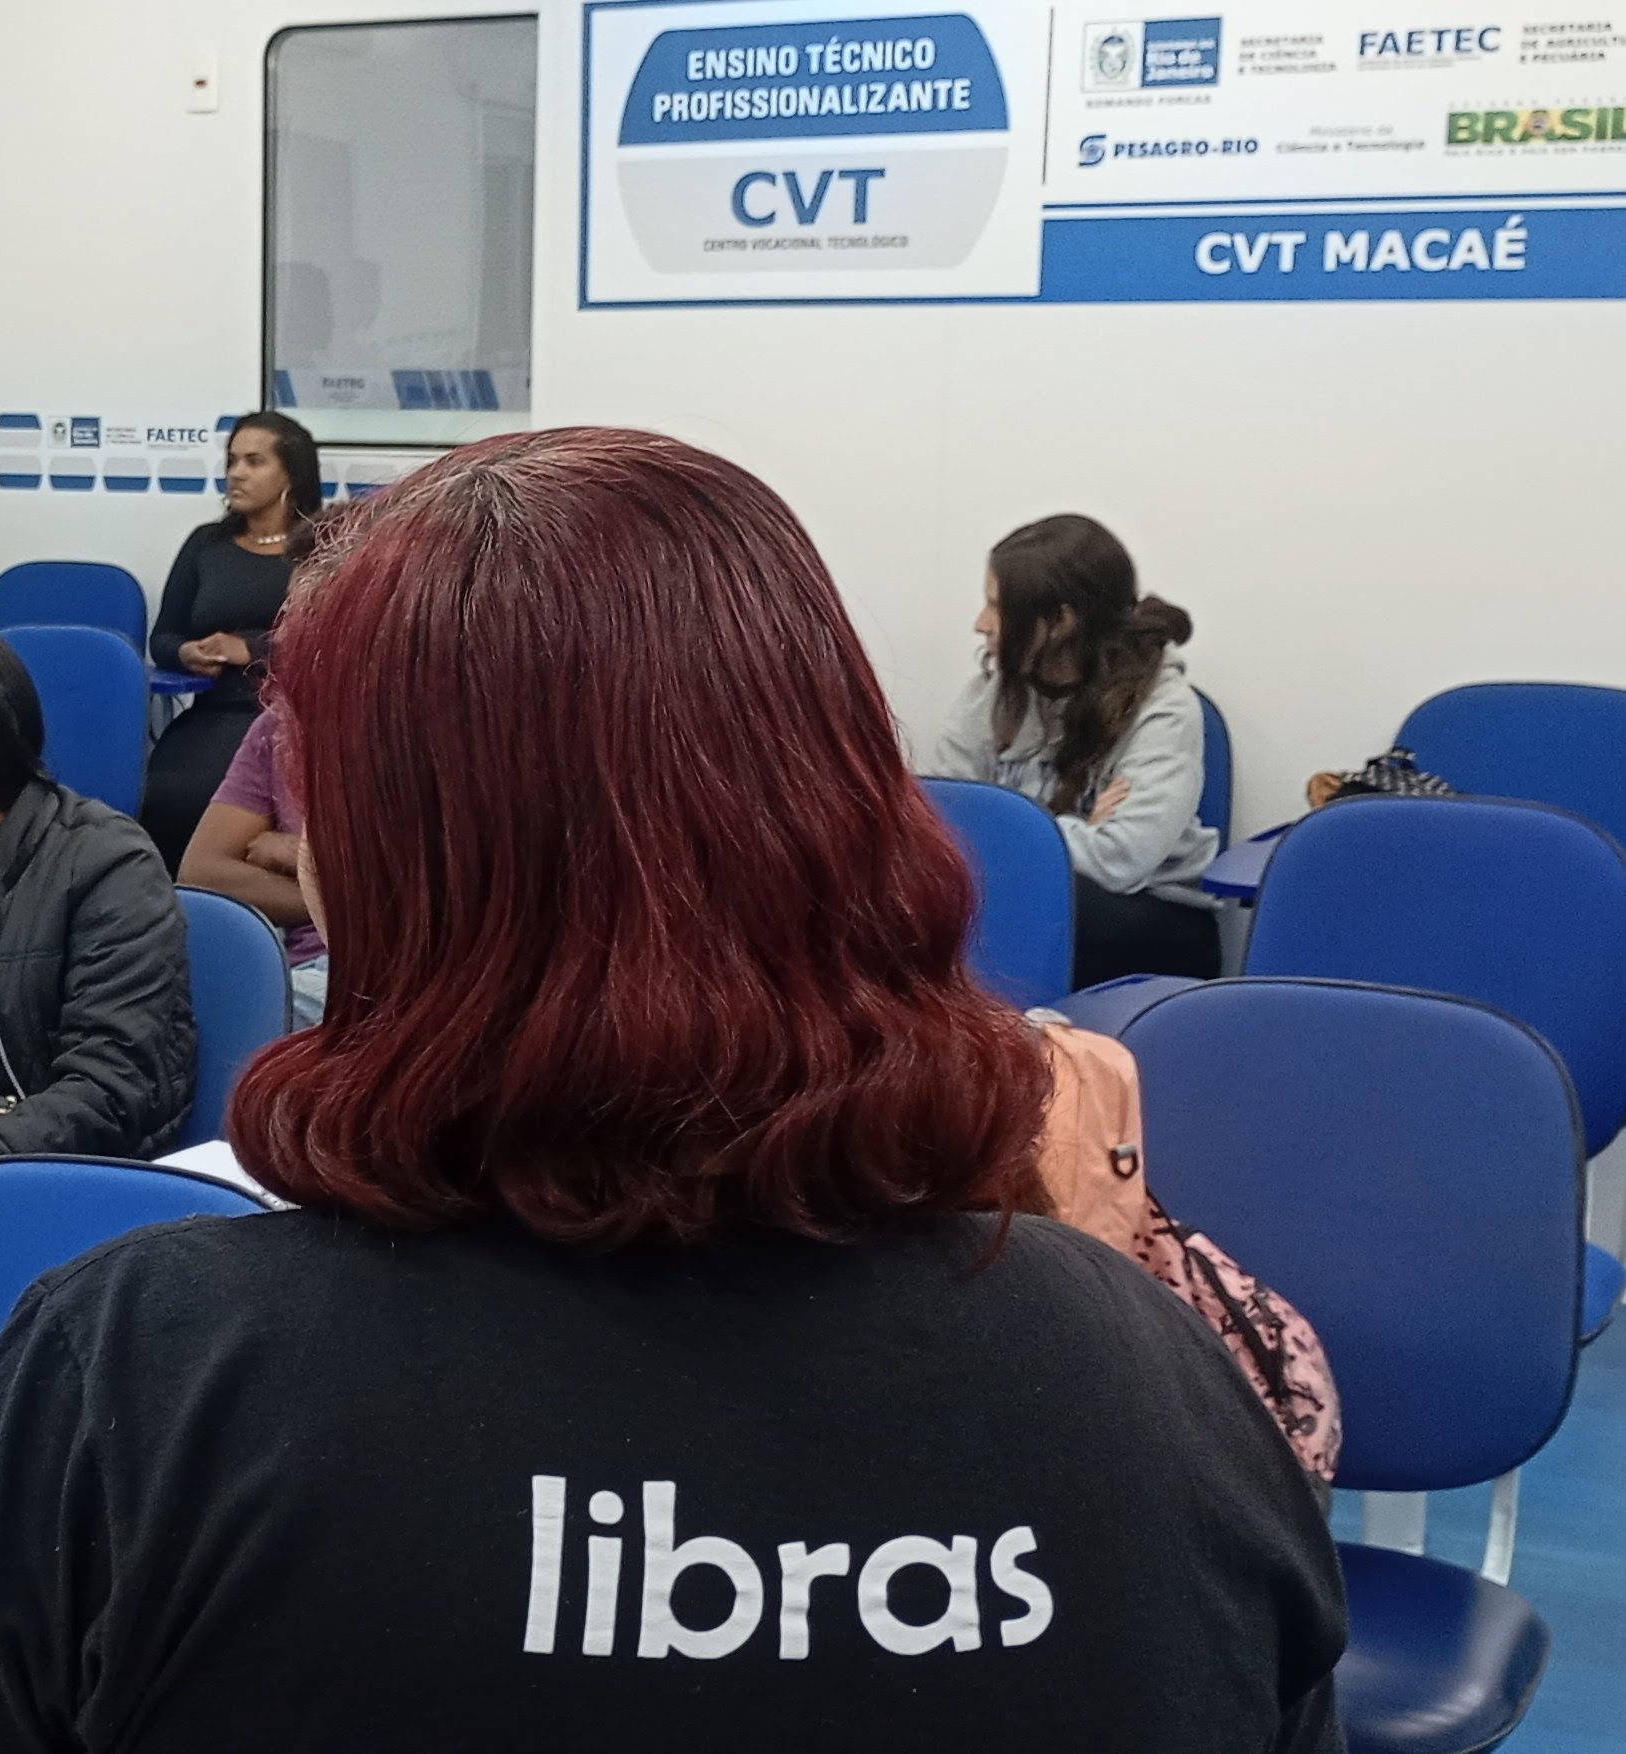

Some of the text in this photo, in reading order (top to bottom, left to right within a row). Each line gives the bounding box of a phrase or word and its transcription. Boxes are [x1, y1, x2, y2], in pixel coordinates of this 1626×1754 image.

[686, 36, 937, 81] ENSINO TÉCNICO
[1359, 26, 1501, 56] FAETEC
[652, 78, 972, 123] PROFISSIONALIZANTE
[730, 167, 886, 229] CVT
[1195, 214, 1529, 276] CVT MACAÉ
[146, 428, 209, 444] FAETEC
[523, 1474, 1054, 1660] libras
